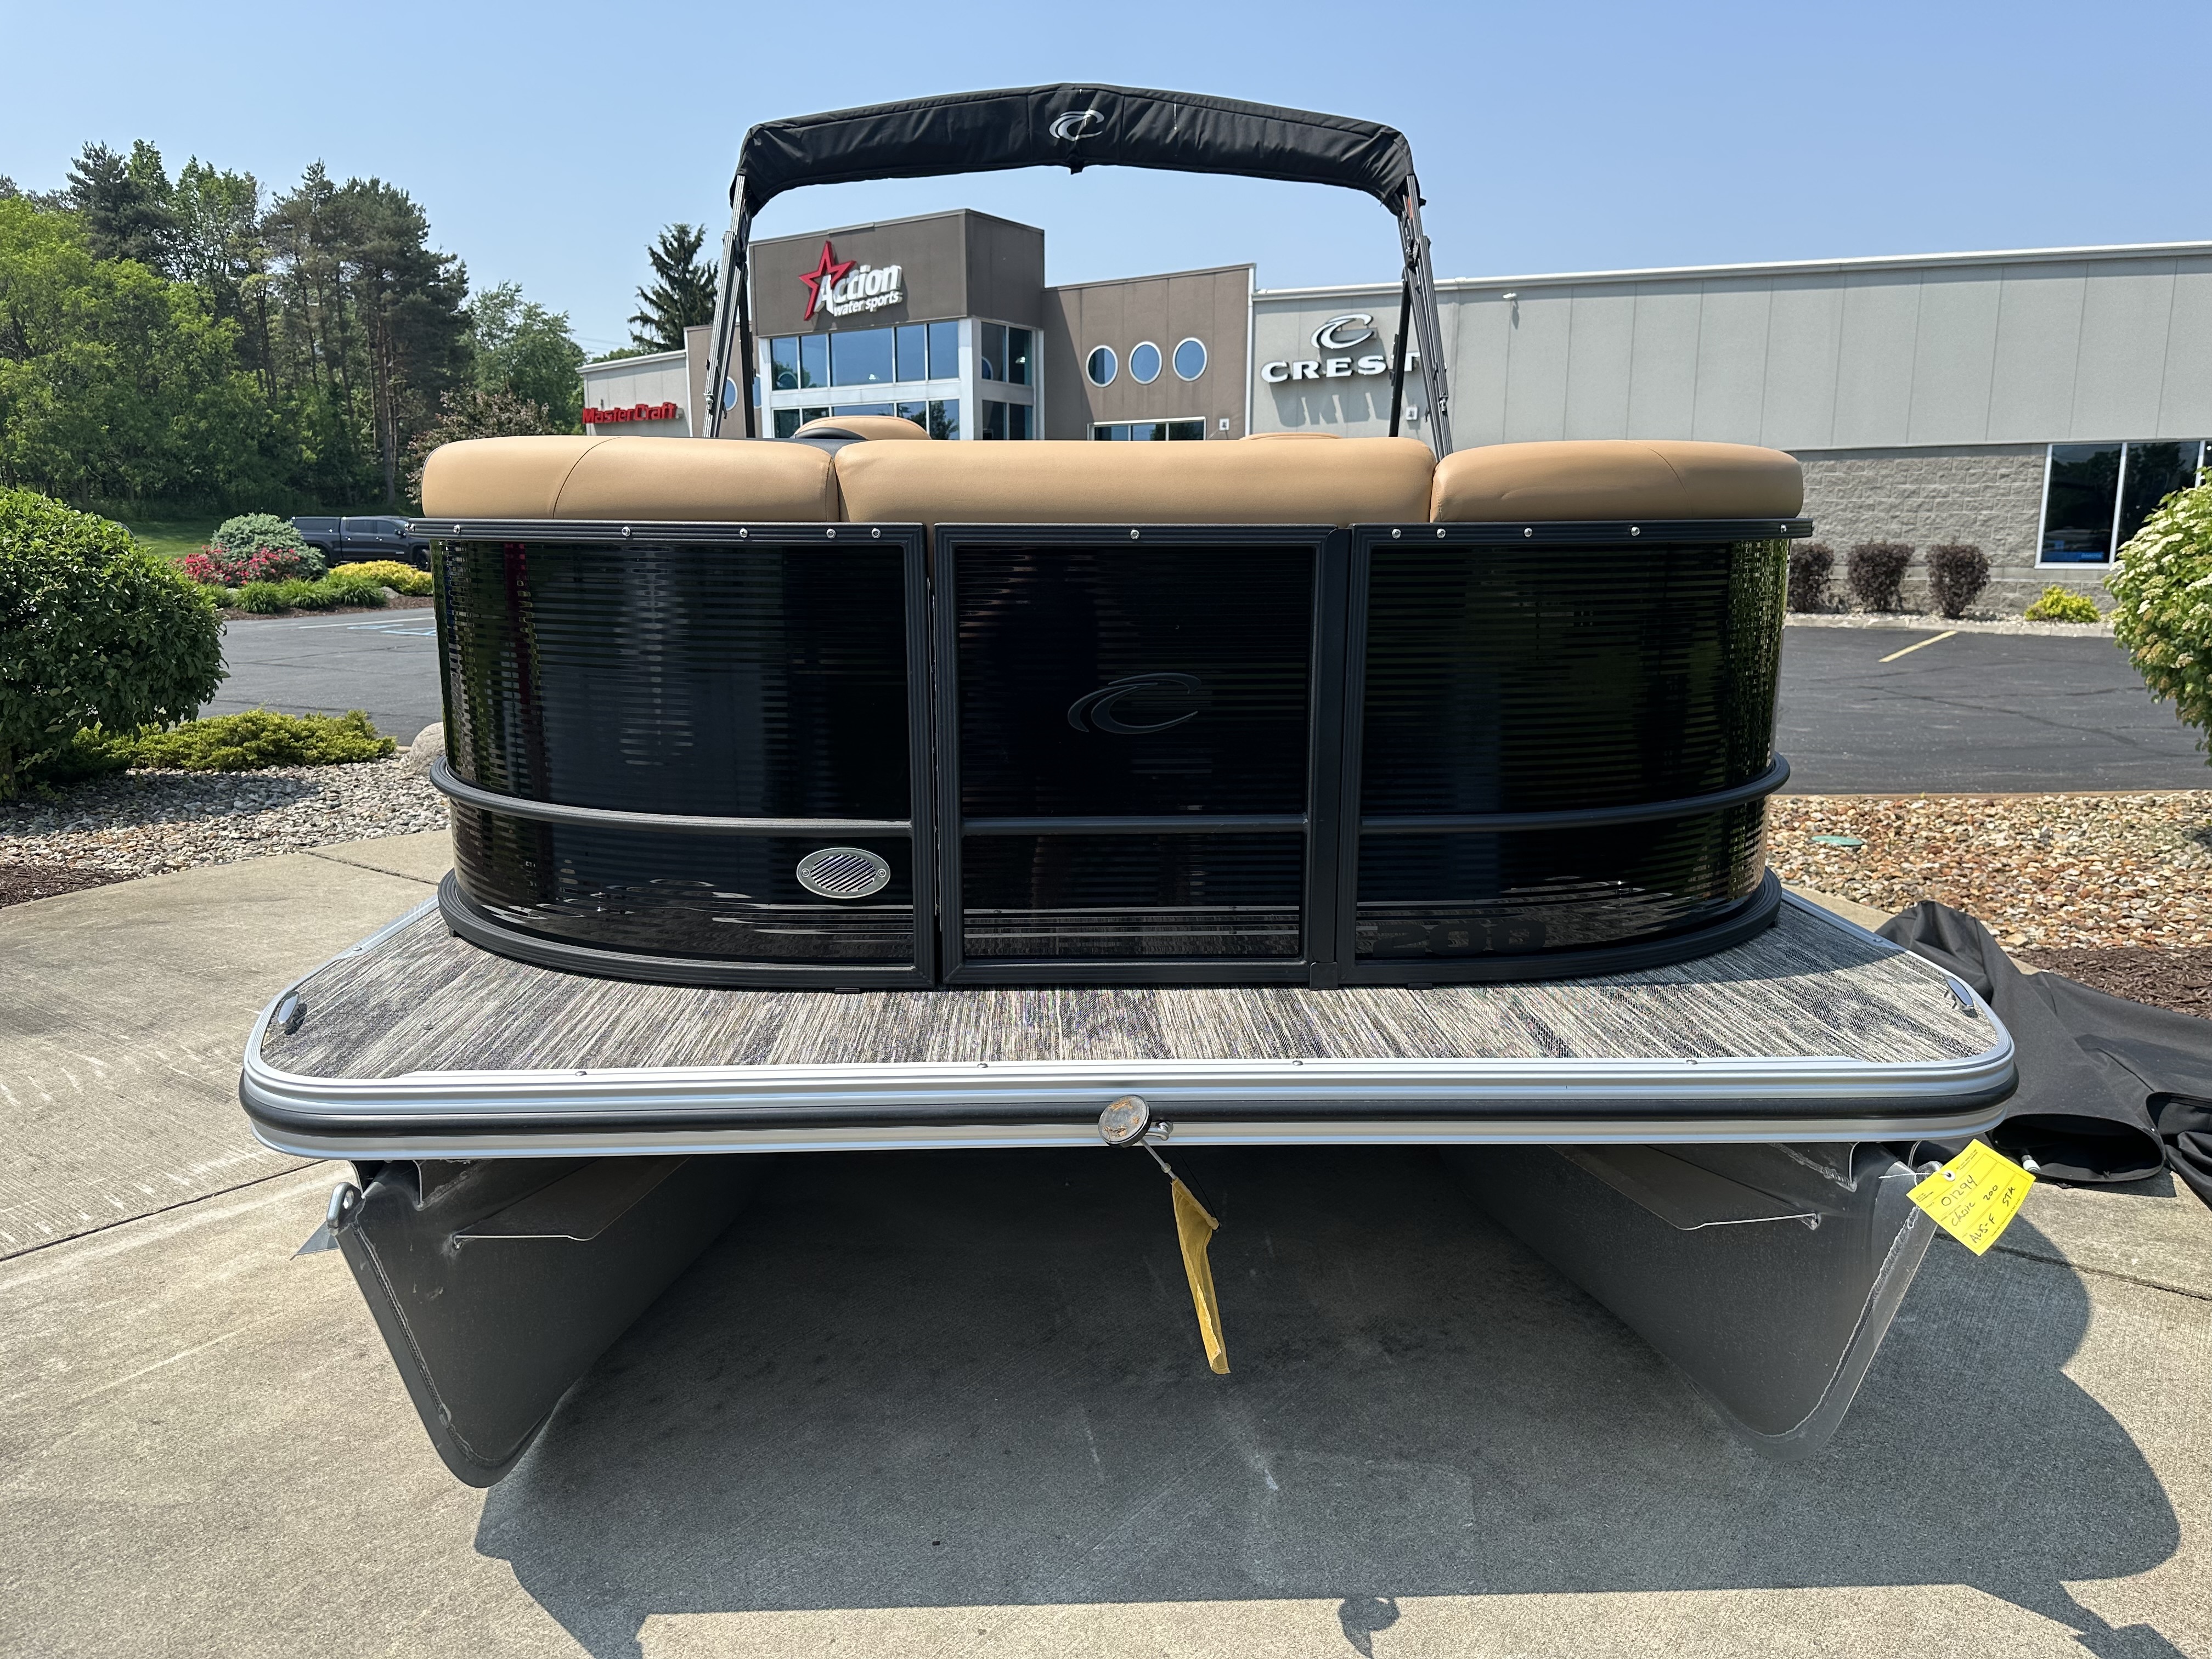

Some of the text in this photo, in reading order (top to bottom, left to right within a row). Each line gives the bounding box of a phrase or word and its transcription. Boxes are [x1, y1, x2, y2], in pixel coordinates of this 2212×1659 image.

[814, 265, 902, 314] Action
[834, 291, 901, 317] water sports
[582, 402, 678, 424] MasterCraft
[1373, 921, 1546, 957] 200
[1941, 1175, 1978, 1206] 01294
[1983, 1185, 1998, 1201] 200
